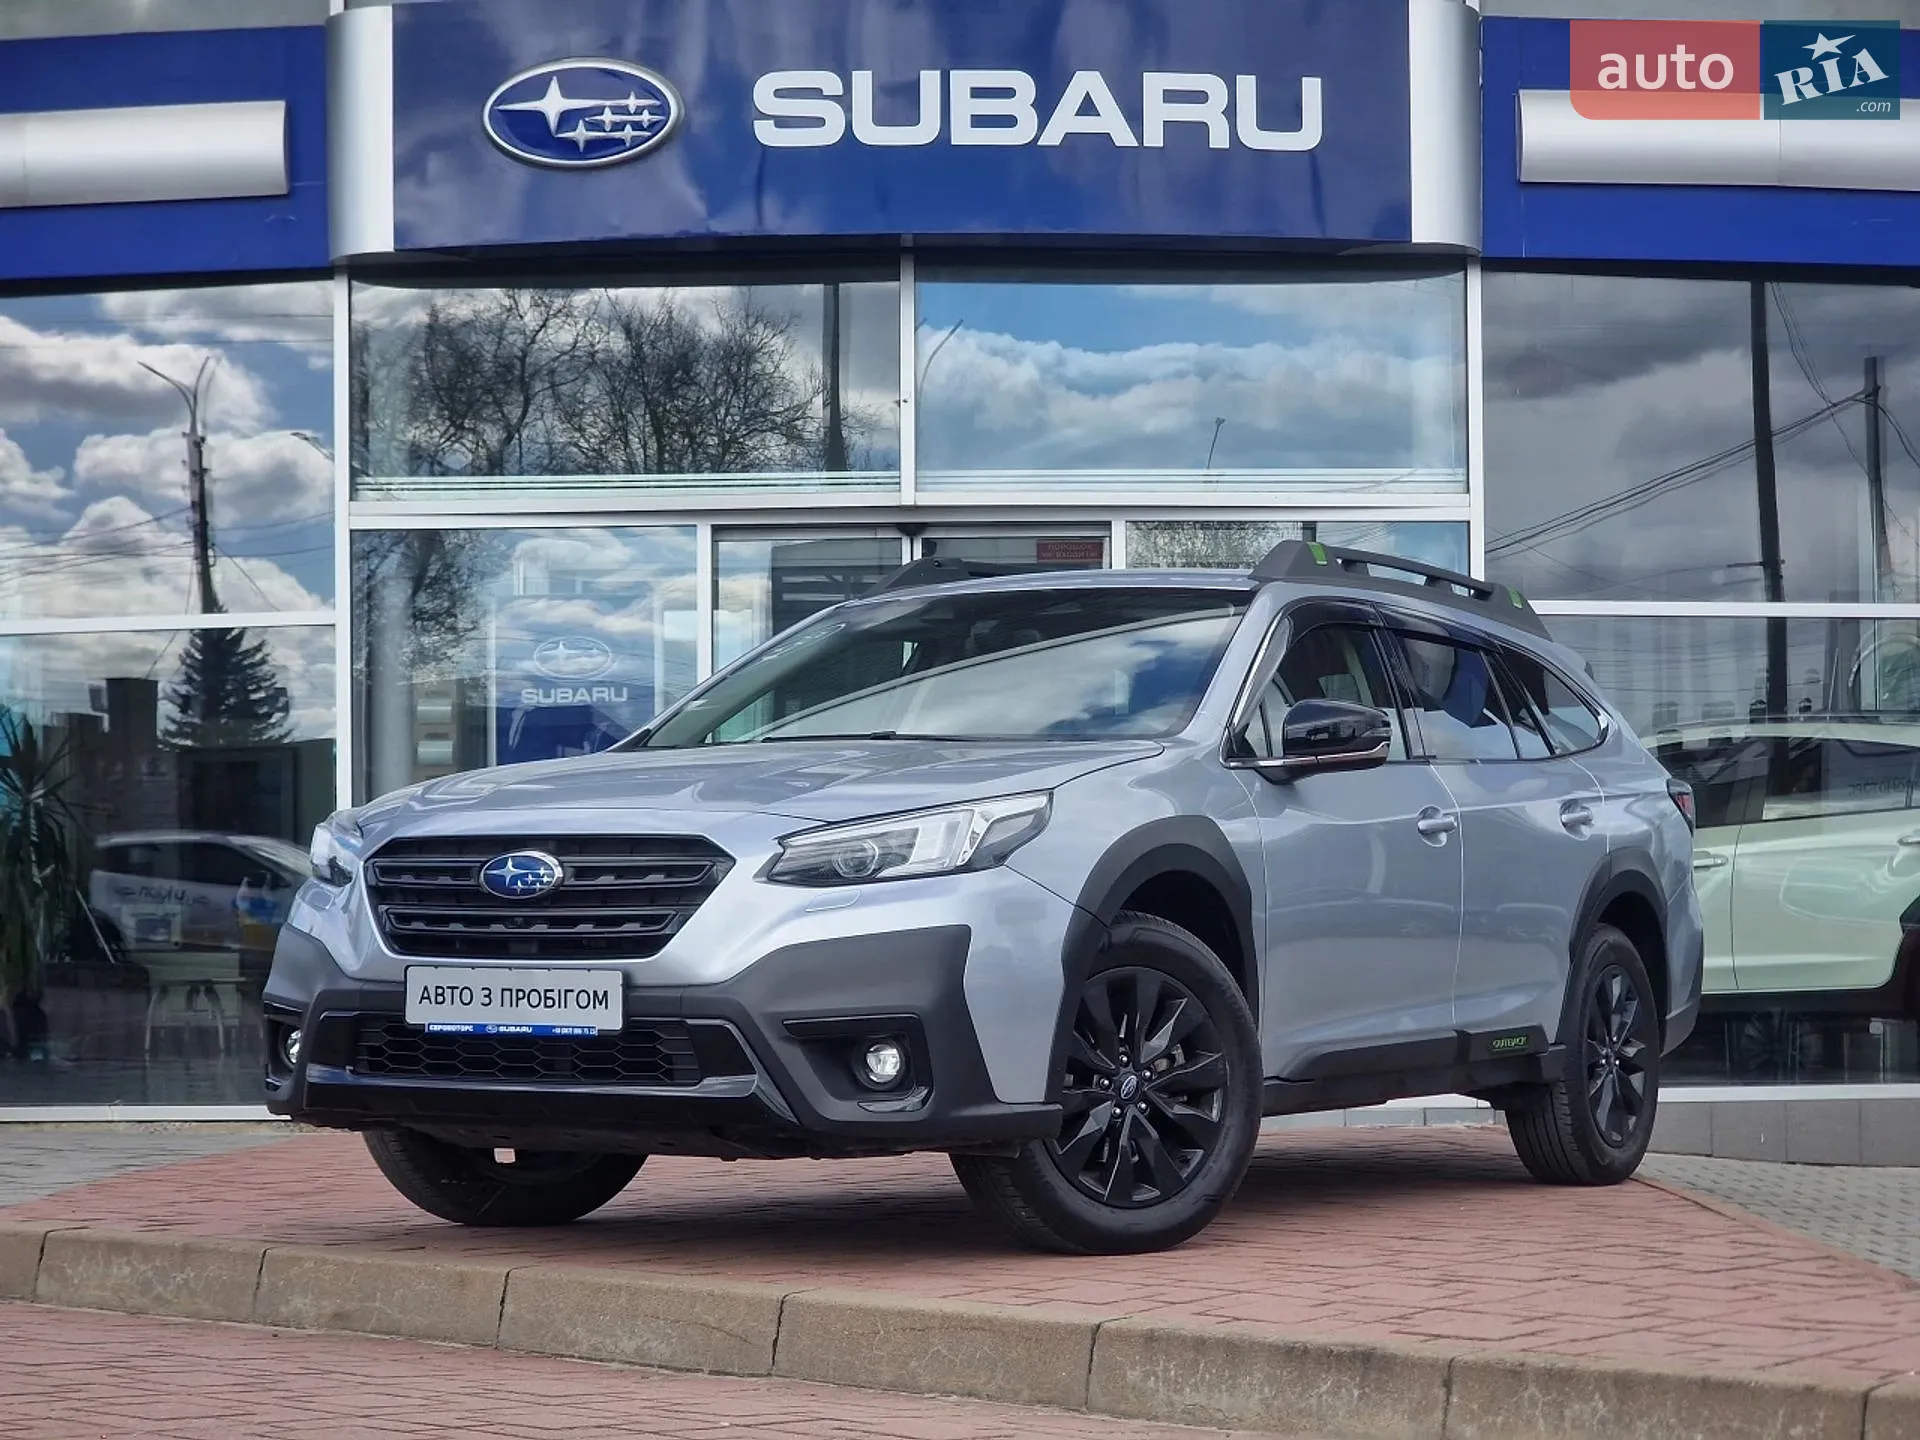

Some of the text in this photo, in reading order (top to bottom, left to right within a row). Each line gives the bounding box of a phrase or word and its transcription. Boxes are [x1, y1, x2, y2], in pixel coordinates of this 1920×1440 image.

[752, 69, 1323, 151] SUBARU
[521, 687, 628, 703] SUBARU
[418, 985, 609, 1010] АВТО З ПРОБІГОМ
